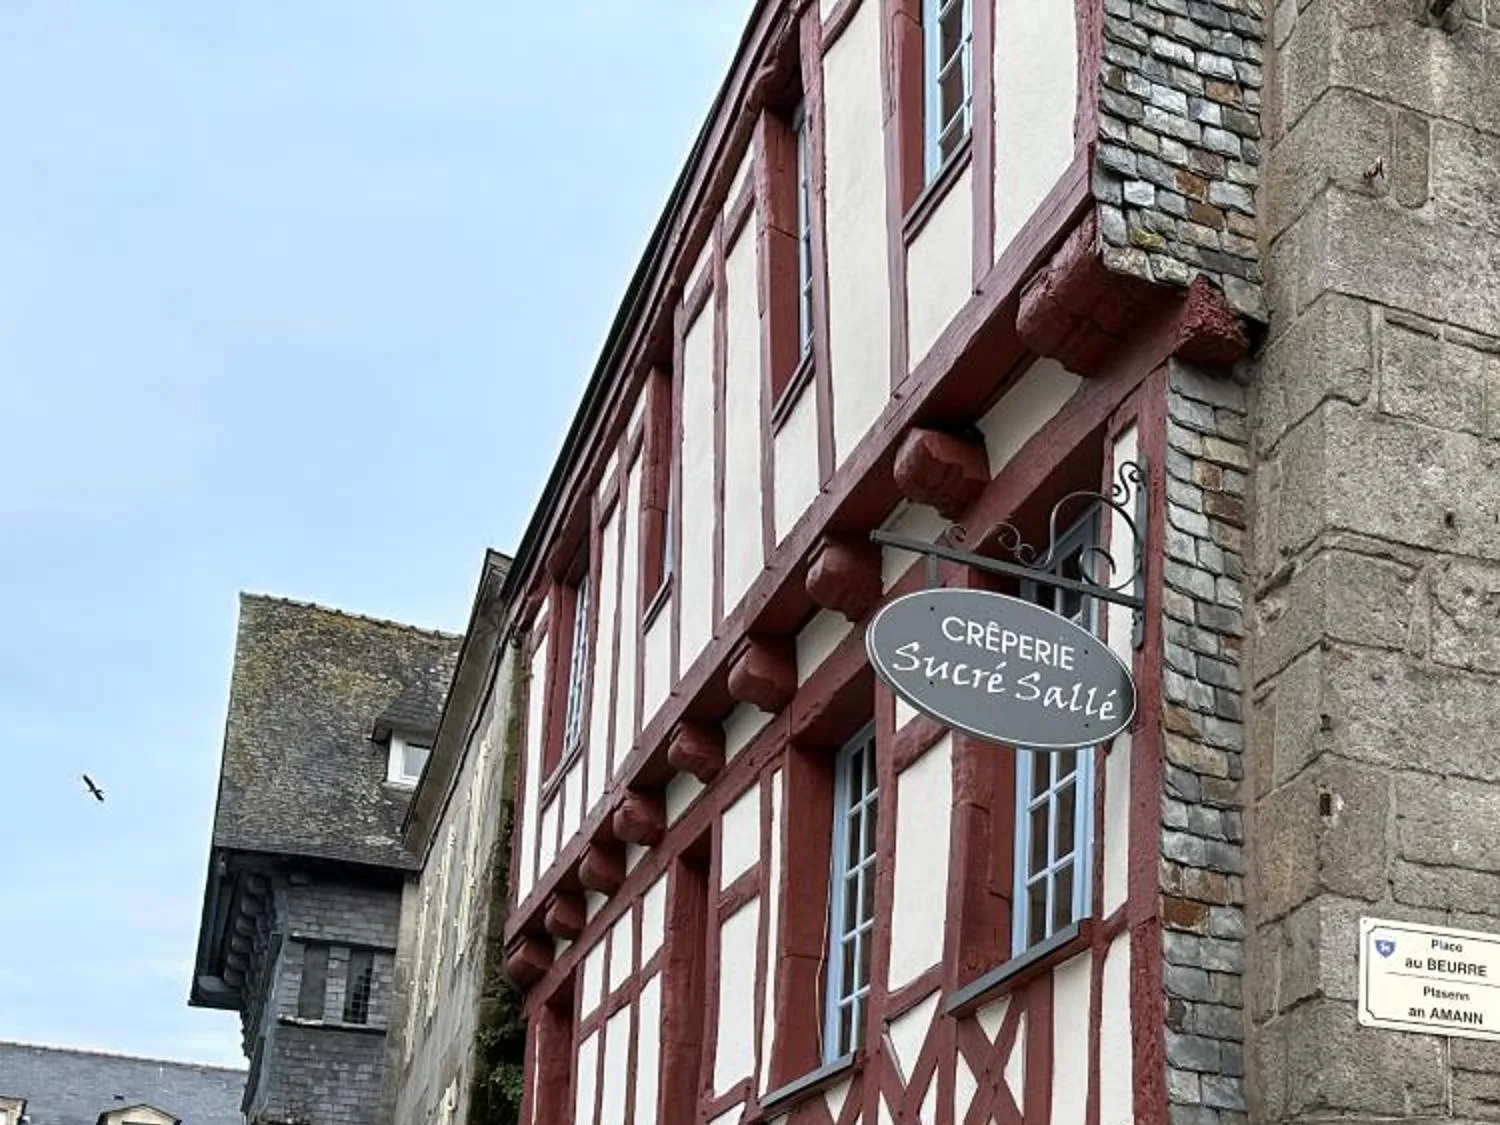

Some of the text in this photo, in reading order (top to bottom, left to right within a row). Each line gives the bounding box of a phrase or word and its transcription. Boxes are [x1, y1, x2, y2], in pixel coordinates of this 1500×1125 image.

[941, 615, 1075, 671] CRÊPERIE
[892, 641, 1117, 721] Sucré Sallé
[1431, 938, 1463, 953] Place
[1405, 957, 1488, 977] au BEURRE
[1423, 986, 1470, 1001] Plasenn
[1408, 1007, 1483, 1025] an AMANN
